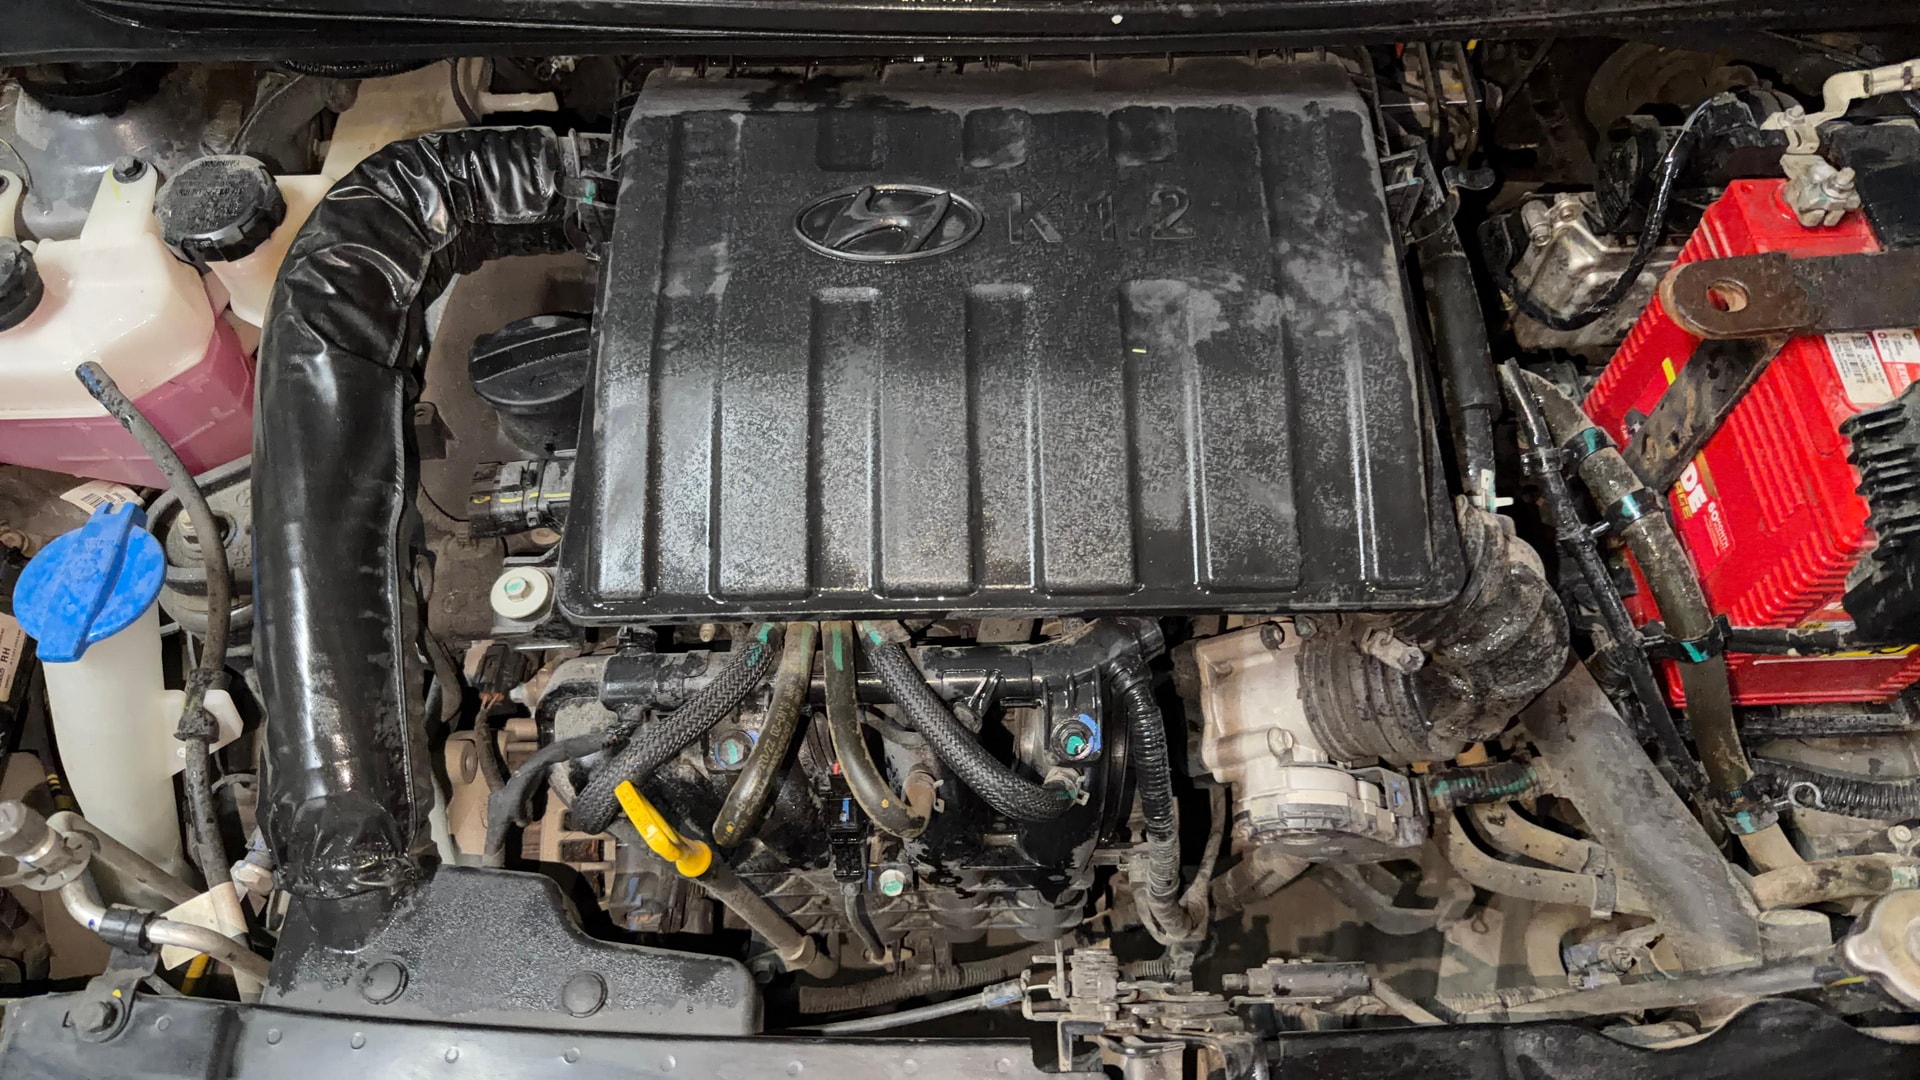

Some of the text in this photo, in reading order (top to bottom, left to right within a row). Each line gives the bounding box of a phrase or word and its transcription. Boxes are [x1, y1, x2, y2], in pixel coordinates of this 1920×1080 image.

[1675, 481, 1693, 519] AGE
[1681, 461, 1708, 514] DE
[1, 647, 11, 663] RH
